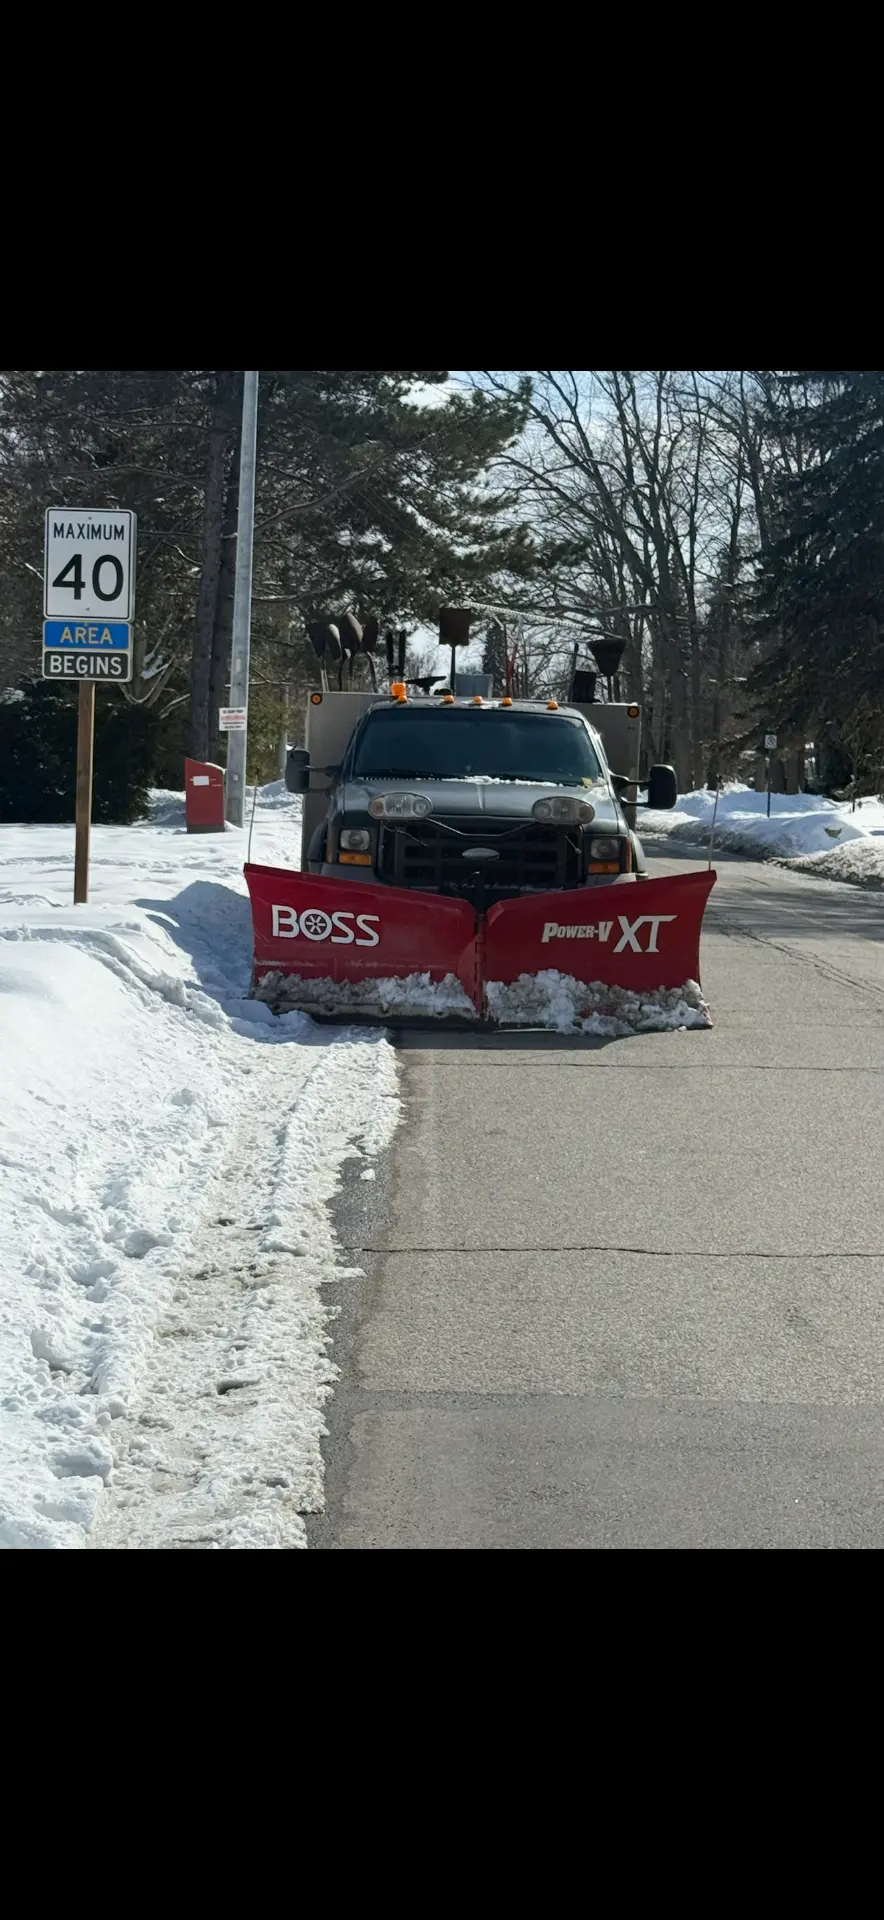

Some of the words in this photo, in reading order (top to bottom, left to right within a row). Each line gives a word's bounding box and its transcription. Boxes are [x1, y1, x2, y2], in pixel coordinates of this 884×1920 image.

[53, 522, 125, 541] MAXIMUM
[52, 553, 124, 602] 40
[59, 626, 113, 645] AREA
[49, 654, 122, 675] BEGINS
[271, 904, 380, 947] BOSS
[612, 915, 678, 953] XT
